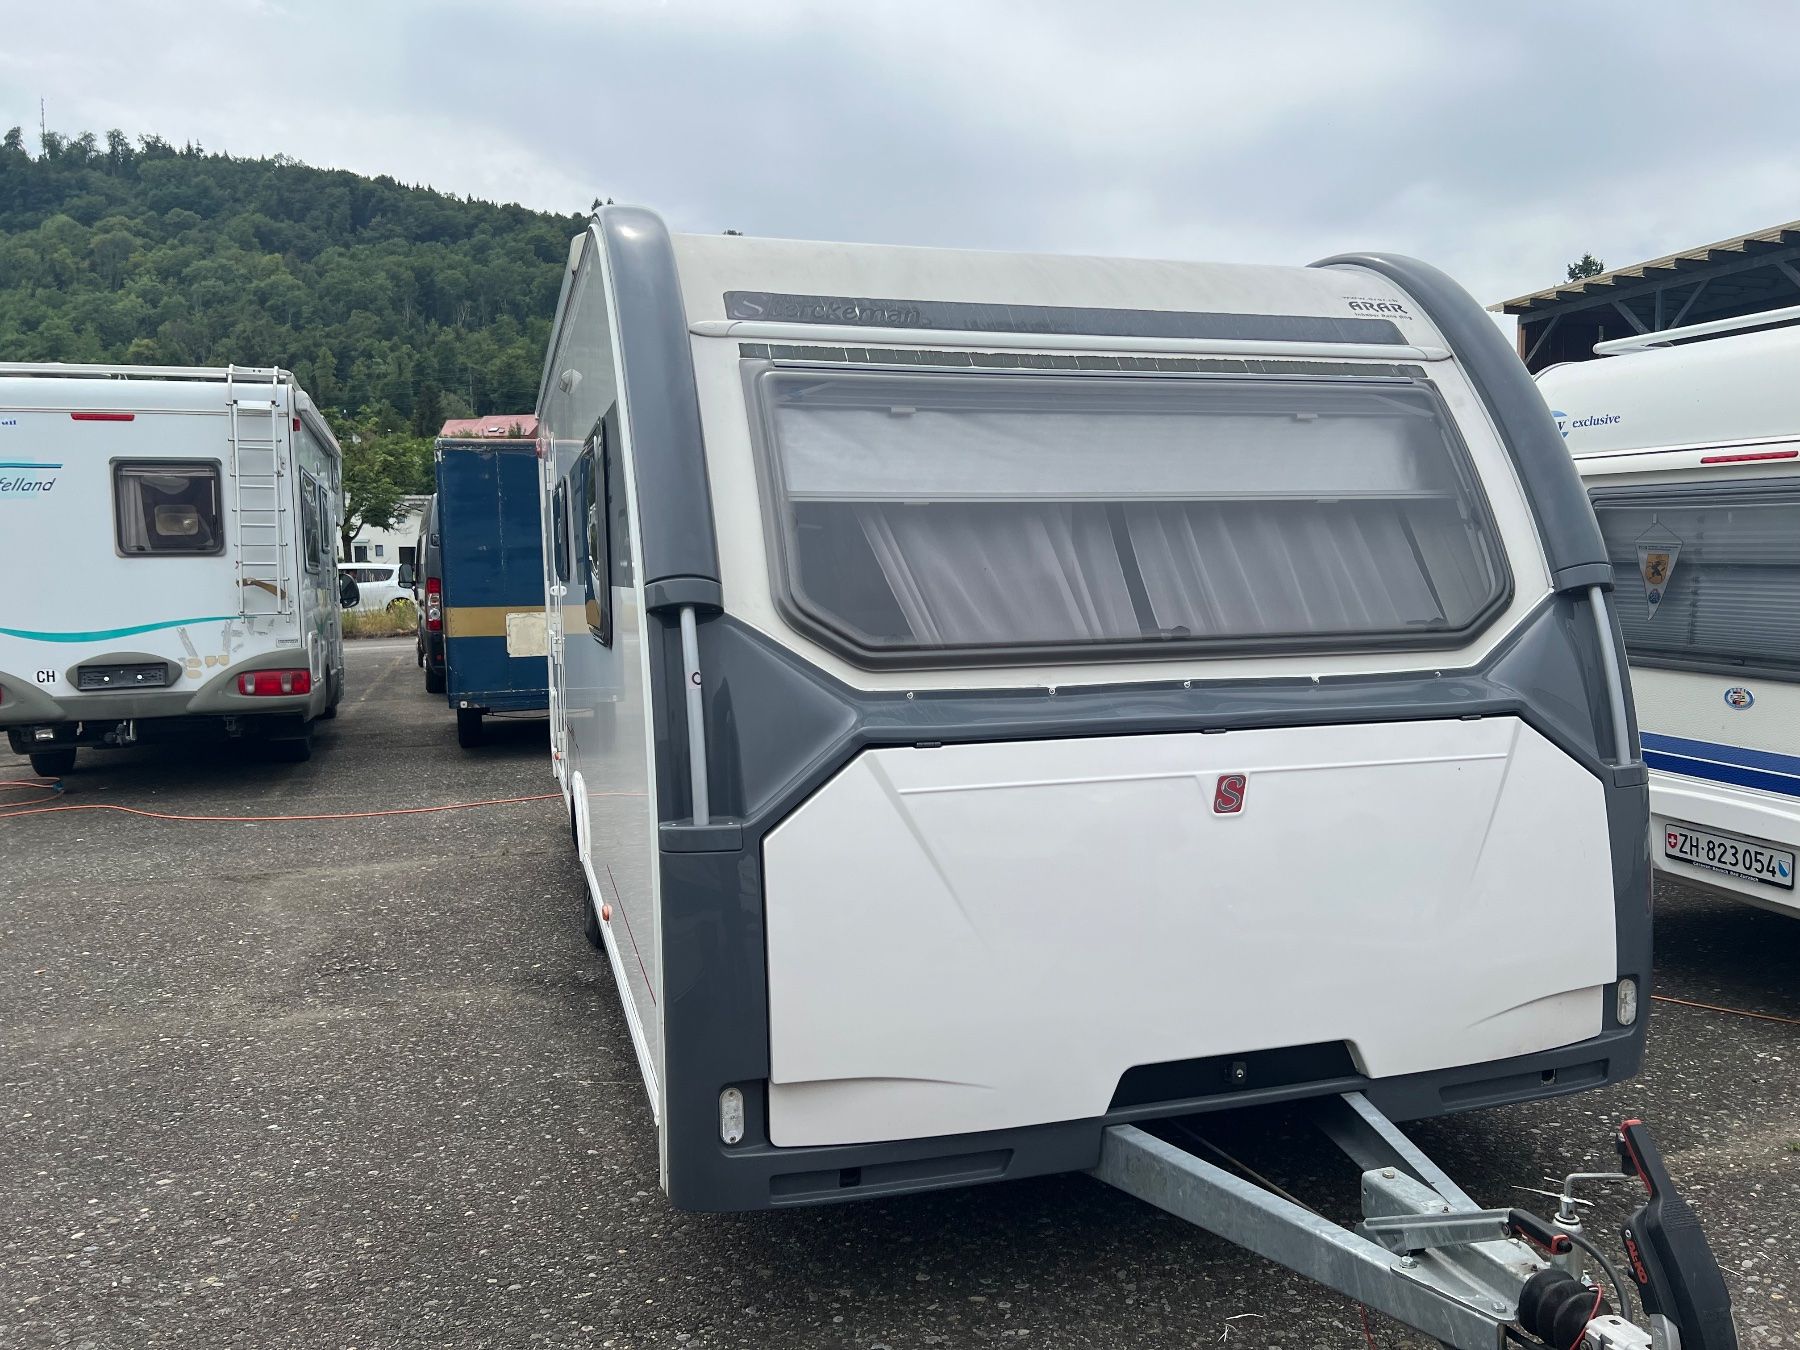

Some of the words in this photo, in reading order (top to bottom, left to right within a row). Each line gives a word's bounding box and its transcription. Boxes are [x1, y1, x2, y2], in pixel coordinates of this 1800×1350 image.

[1348, 301, 1408, 314] ARAR
[1572, 413, 1621, 429] exclusive
[36, 670, 56, 683] CH
[1625, 1239, 1648, 1284] AL-KO
